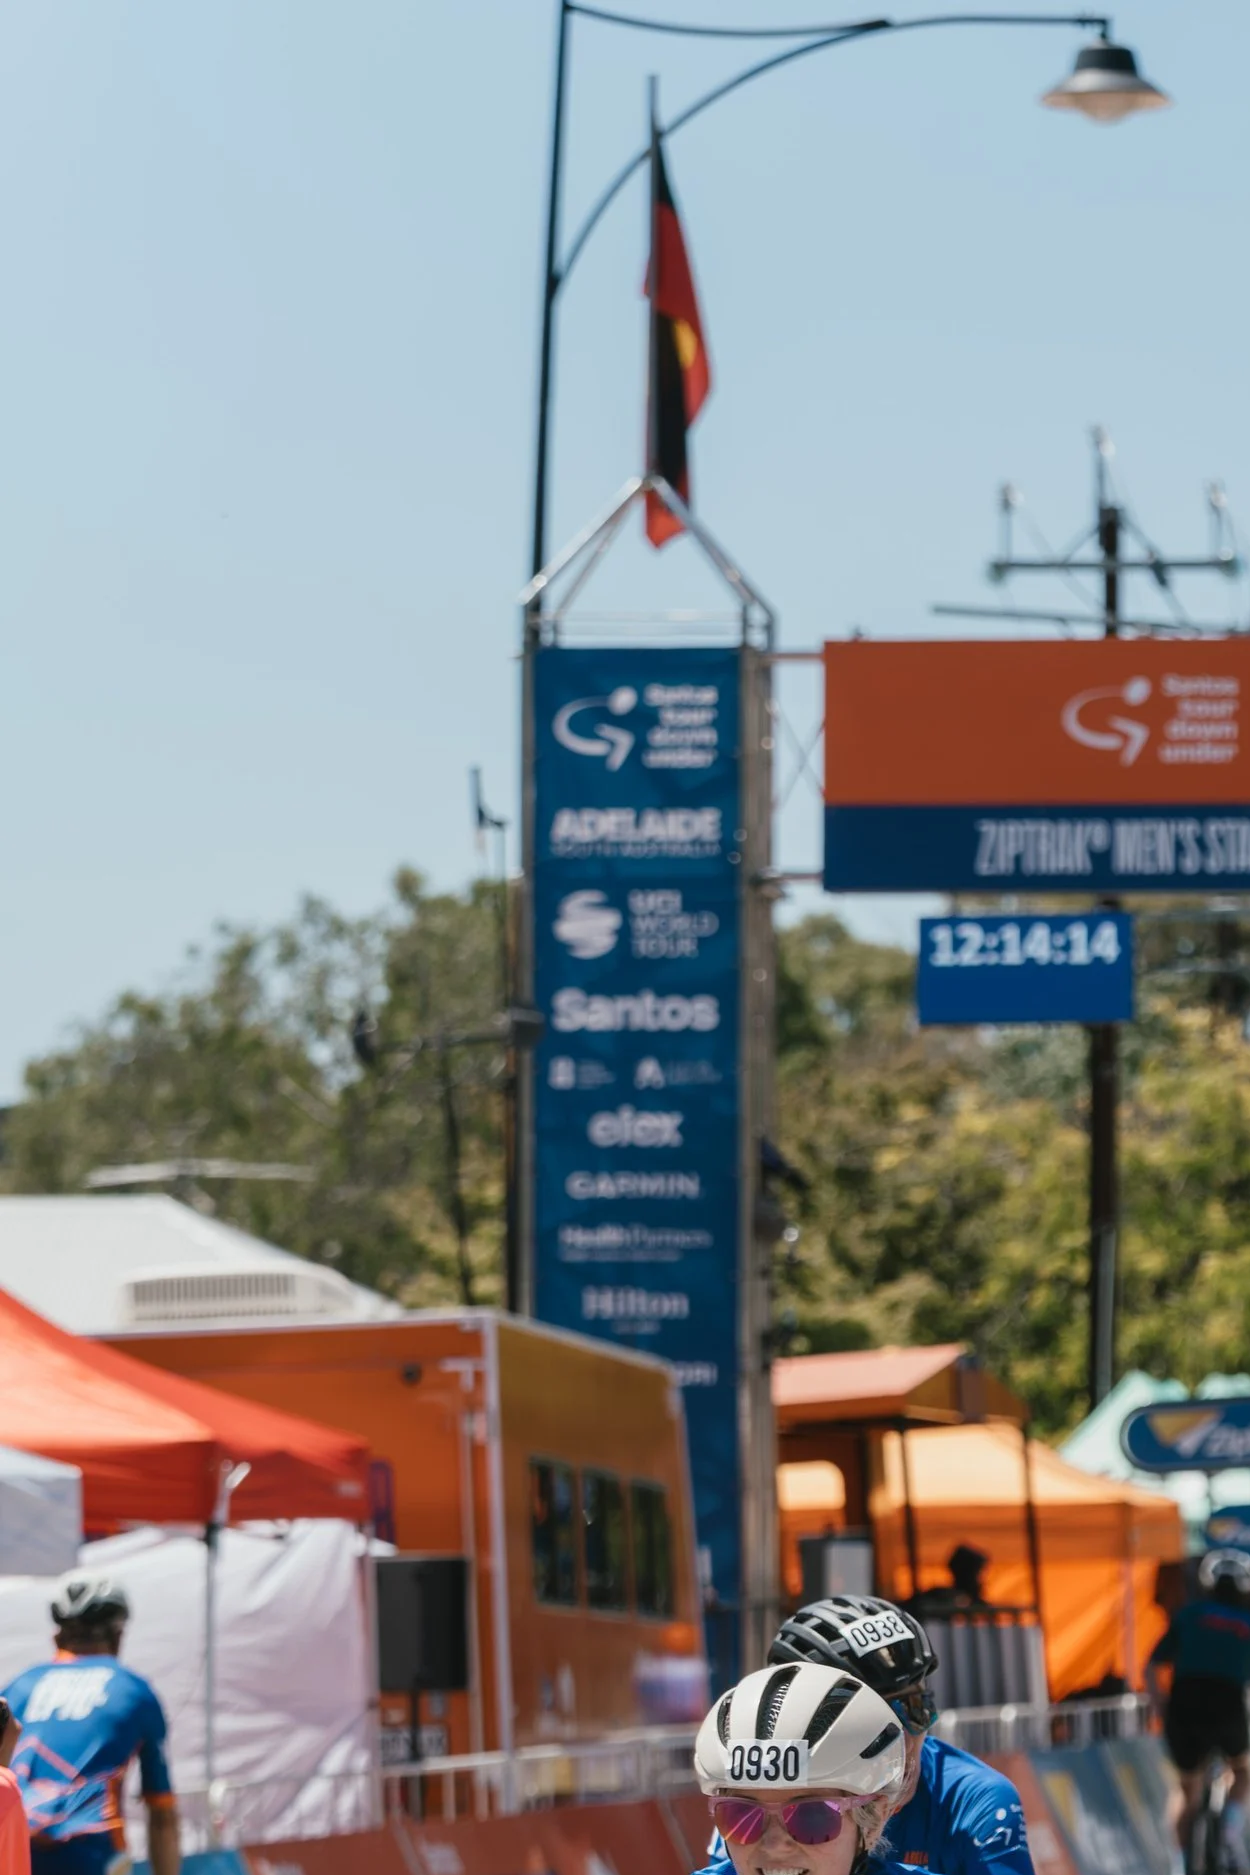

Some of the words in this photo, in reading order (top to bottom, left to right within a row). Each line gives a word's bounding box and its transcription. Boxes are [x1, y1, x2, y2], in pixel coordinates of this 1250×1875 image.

[550, 806, 722, 843] ADELAIDE
[1112, 817, 1201, 875] MEN'S
[929, 921, 1120, 966] 12:14:14
[551, 986, 720, 1033] Santos
[565, 1169, 702, 1201] GARMIN
[580, 1283, 691, 1321] Hilton
[850, 1615, 907, 1649] 0938
[729, 1744, 801, 1782] 0930
